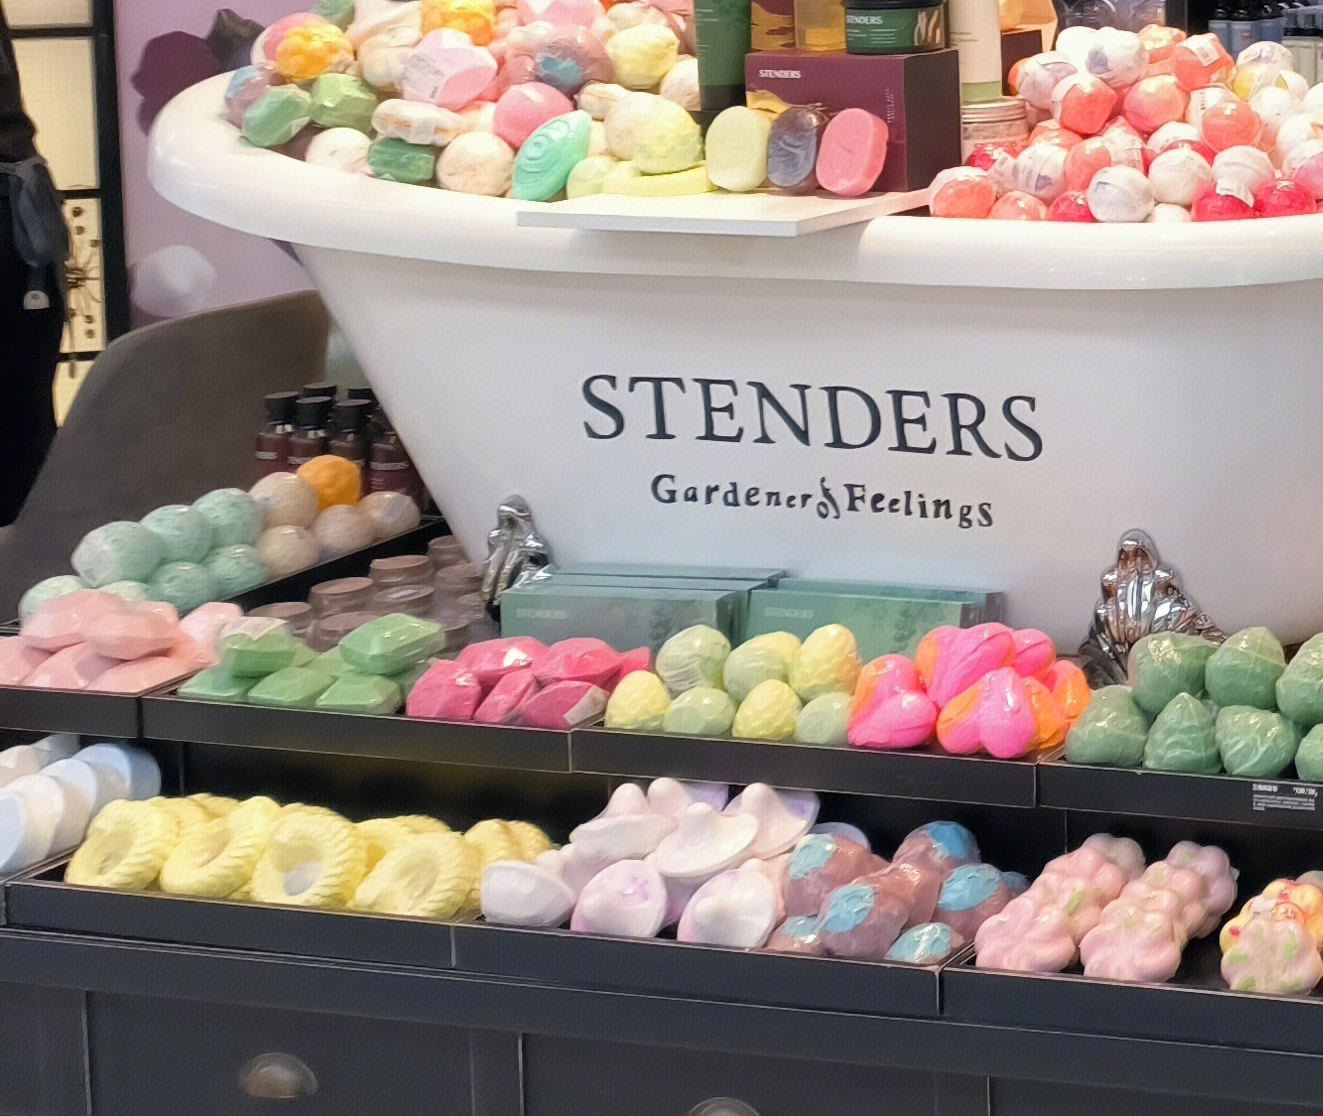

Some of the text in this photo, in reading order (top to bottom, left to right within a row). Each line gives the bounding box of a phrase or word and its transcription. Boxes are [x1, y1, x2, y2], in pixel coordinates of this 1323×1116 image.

[759, 69, 801, 79] STENDERS
[580, 374, 1044, 463] STENDERS
[650, 473, 814, 512] Gardener
[844, 483, 994, 530] Feelings
